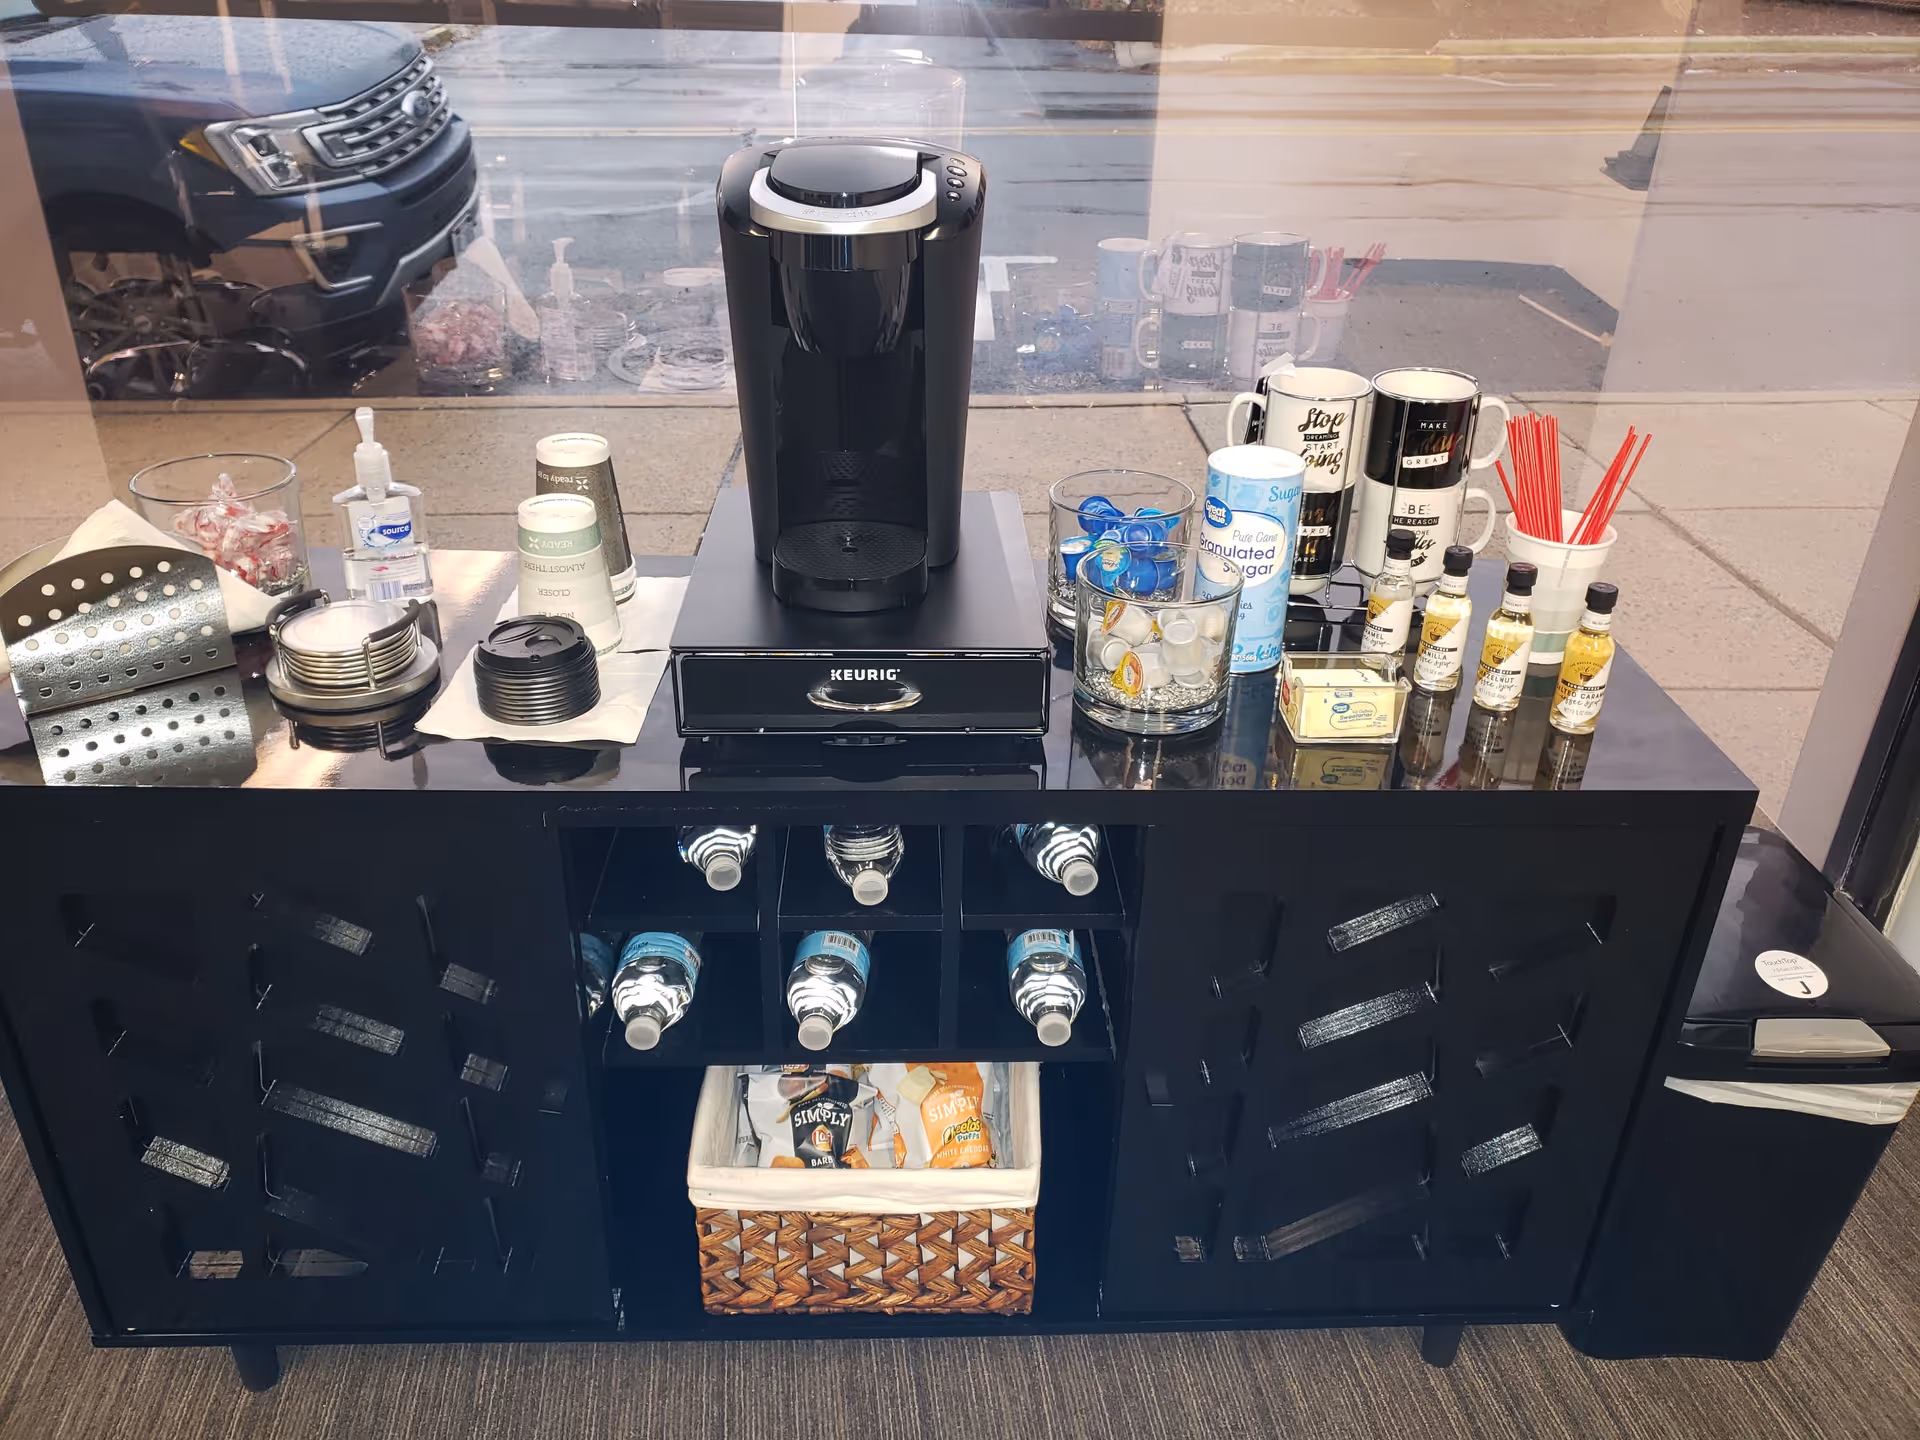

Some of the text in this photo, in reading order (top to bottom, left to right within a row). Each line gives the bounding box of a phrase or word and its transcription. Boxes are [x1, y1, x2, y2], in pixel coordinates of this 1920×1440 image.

[1298, 408, 1348, 434] Stop
[1306, 442, 1338, 450] START
[1301, 449, 1343, 474] oing
[1406, 456, 1447, 465] GREAT
[550, 475, 574, 485] ready
[1268, 485, 1302, 503] Suga
[1206, 500, 1227, 518] Great
[1408, 504, 1426, 515] BE
[1407, 518, 1438, 526] REASON
[382, 524, 410, 536] source
[1232, 529, 1278, 543] Pure Cane
[541, 540, 574, 550] READY
[1200, 532, 1276, 560] Granulated
[523, 560, 586, 573] ALMOST THERE
[537, 587, 571, 597] CLOSER
[831, 669, 897, 680] KEURIG
[928, 1096, 980, 1122] SIMPLY
[794, 1106, 851, 1128] SIMPLY
[943, 1117, 981, 1146] Cheetos
[957, 1132, 980, 1142] Puffs
[936, 1148, 958, 1159] WHITE
